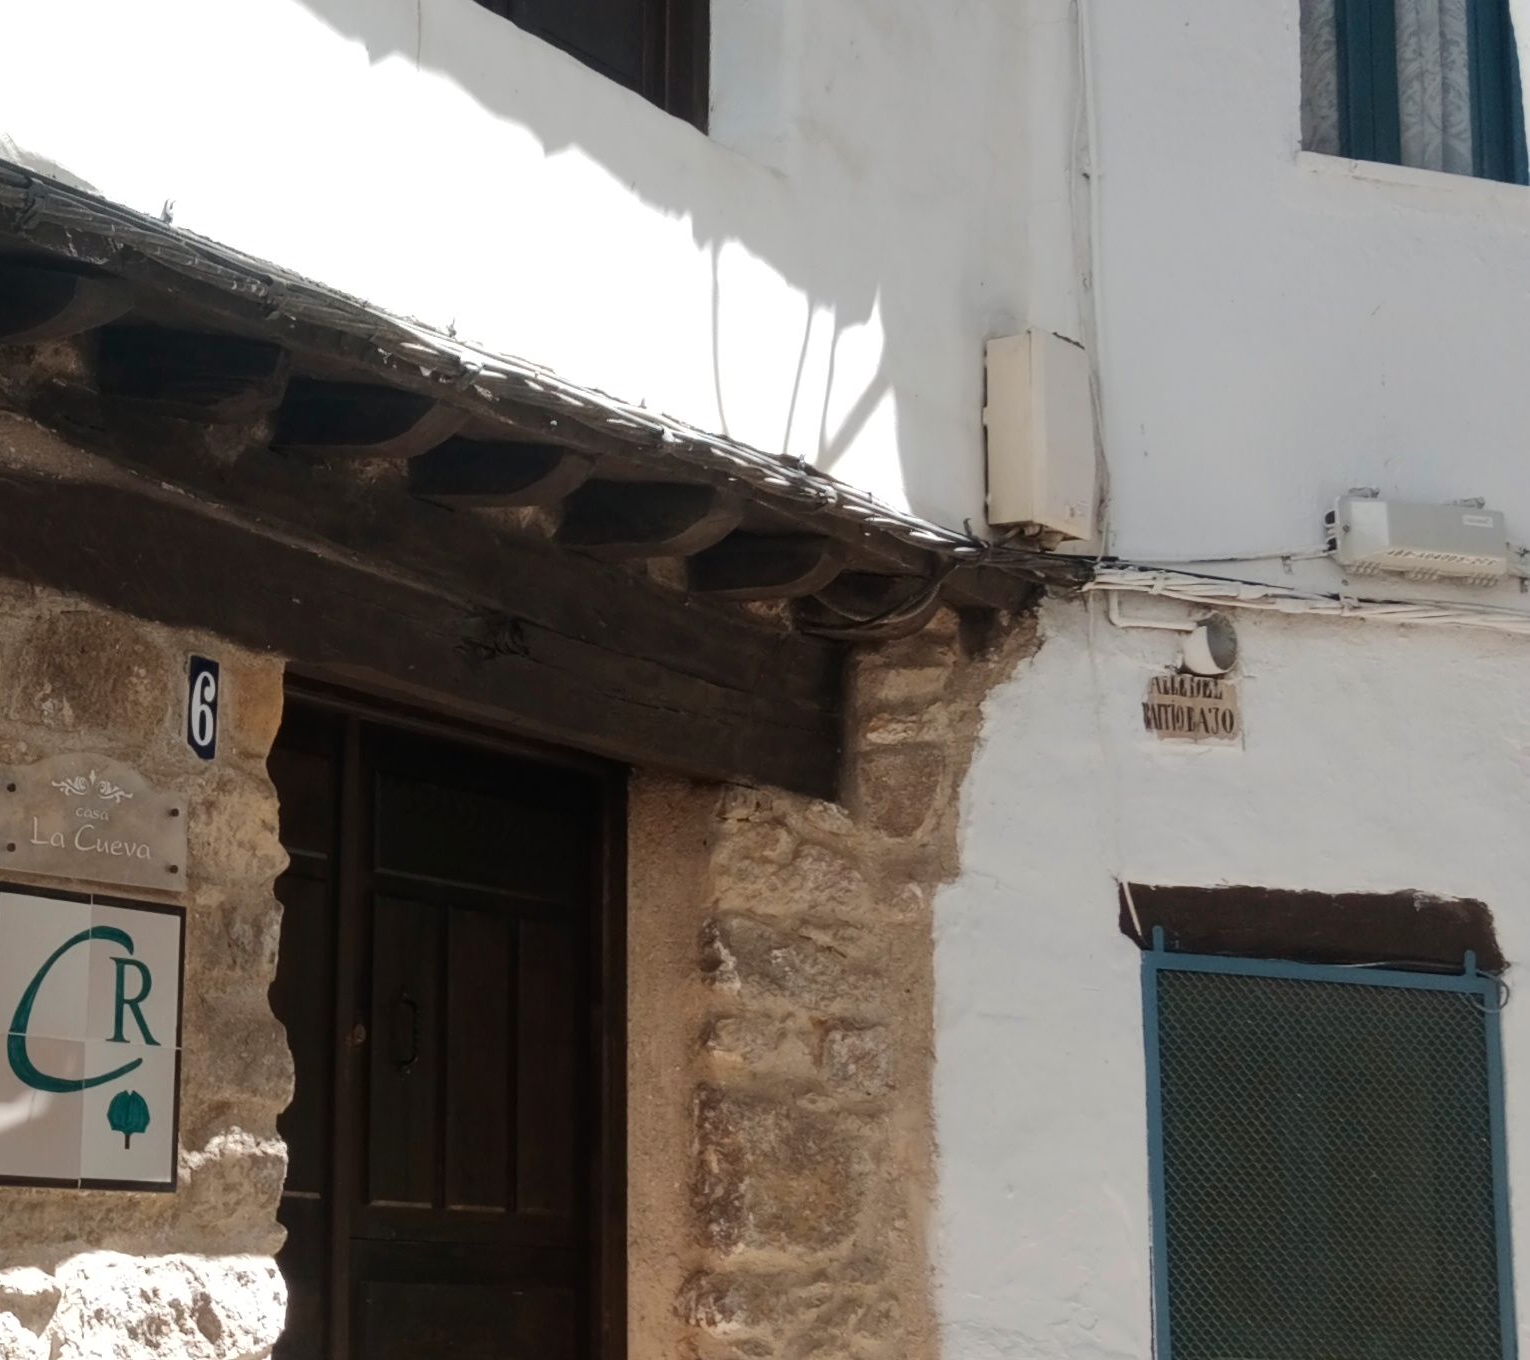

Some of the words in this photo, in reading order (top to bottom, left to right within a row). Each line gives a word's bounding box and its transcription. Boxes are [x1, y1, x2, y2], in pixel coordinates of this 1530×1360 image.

[1150, 675, 1187, 698] ALLE
[191, 671, 215, 746] 6
[75, 807, 110, 821] casa
[29, 816, 66, 849] La
[74, 824, 152, 859] Cueva
